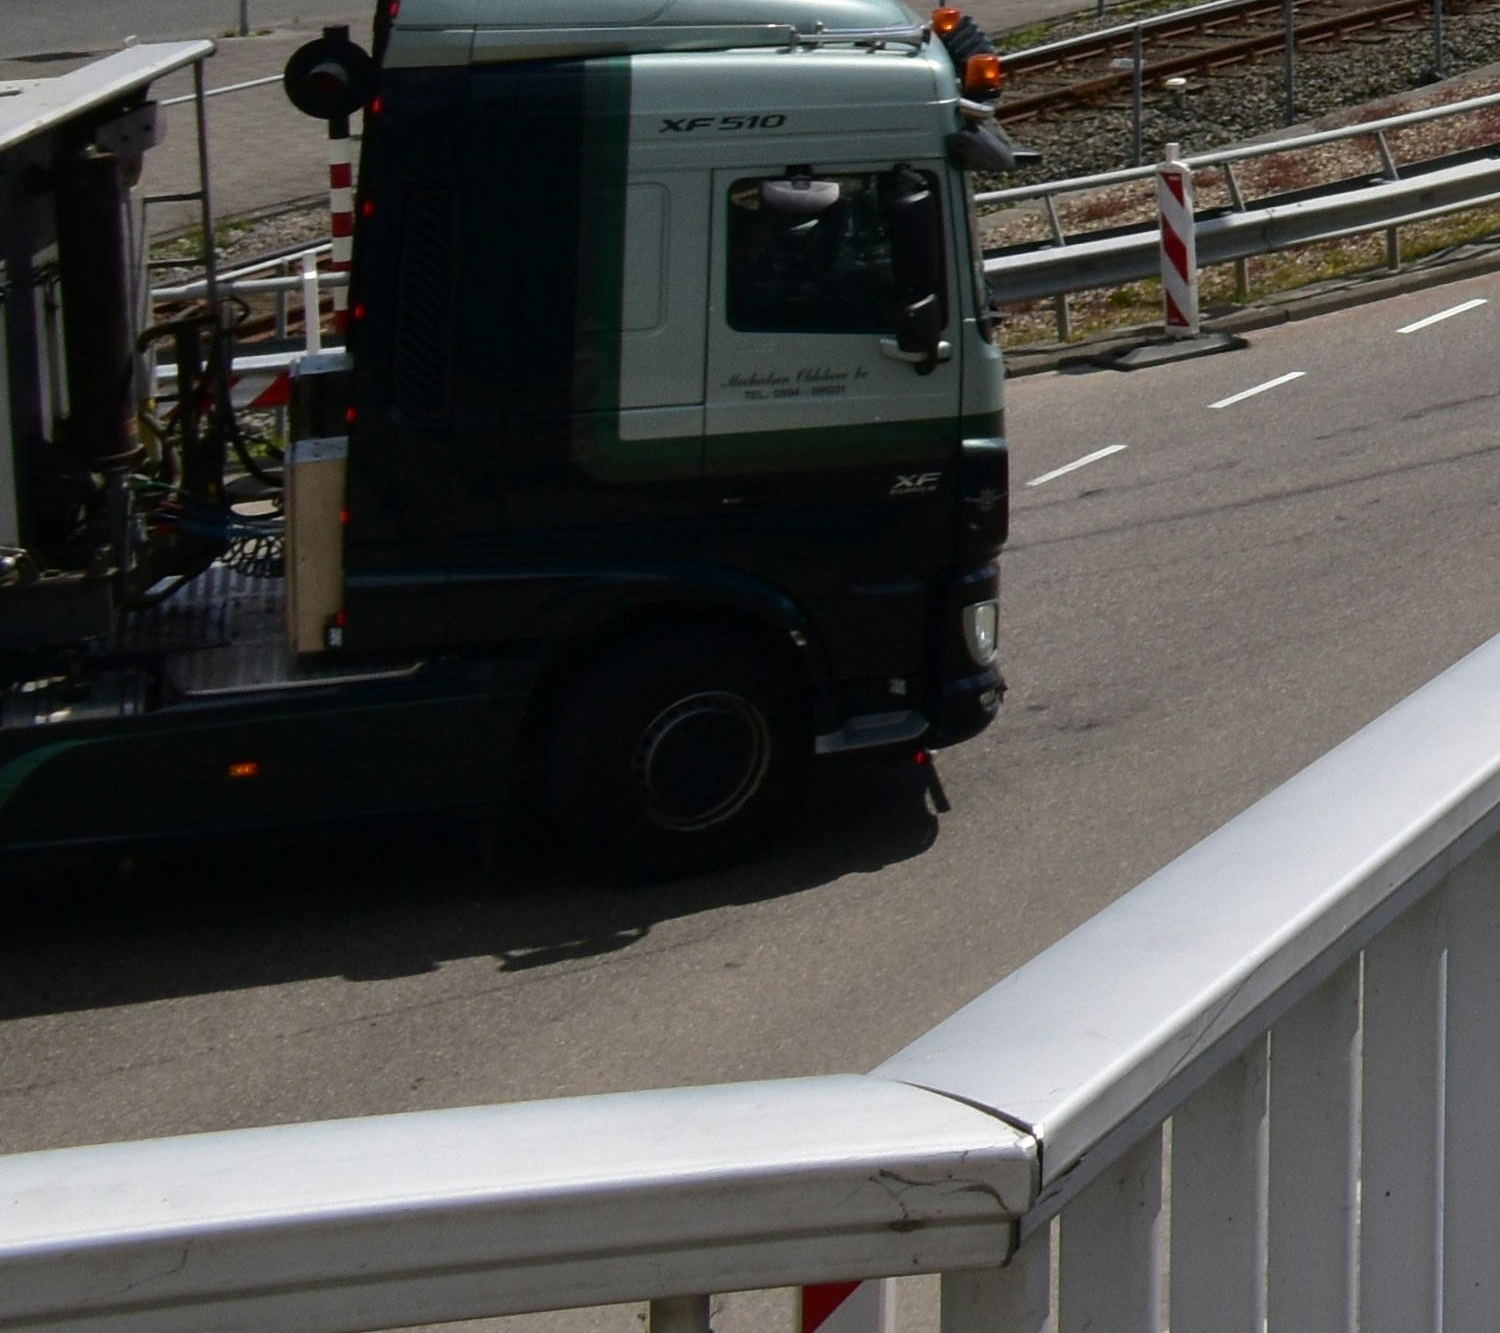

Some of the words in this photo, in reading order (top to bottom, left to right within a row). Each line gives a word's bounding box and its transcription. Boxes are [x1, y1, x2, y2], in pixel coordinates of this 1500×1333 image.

[659, 118, 715, 133] XF
[718, 114, 786, 131] 510
[892, 472, 943, 487] XF
